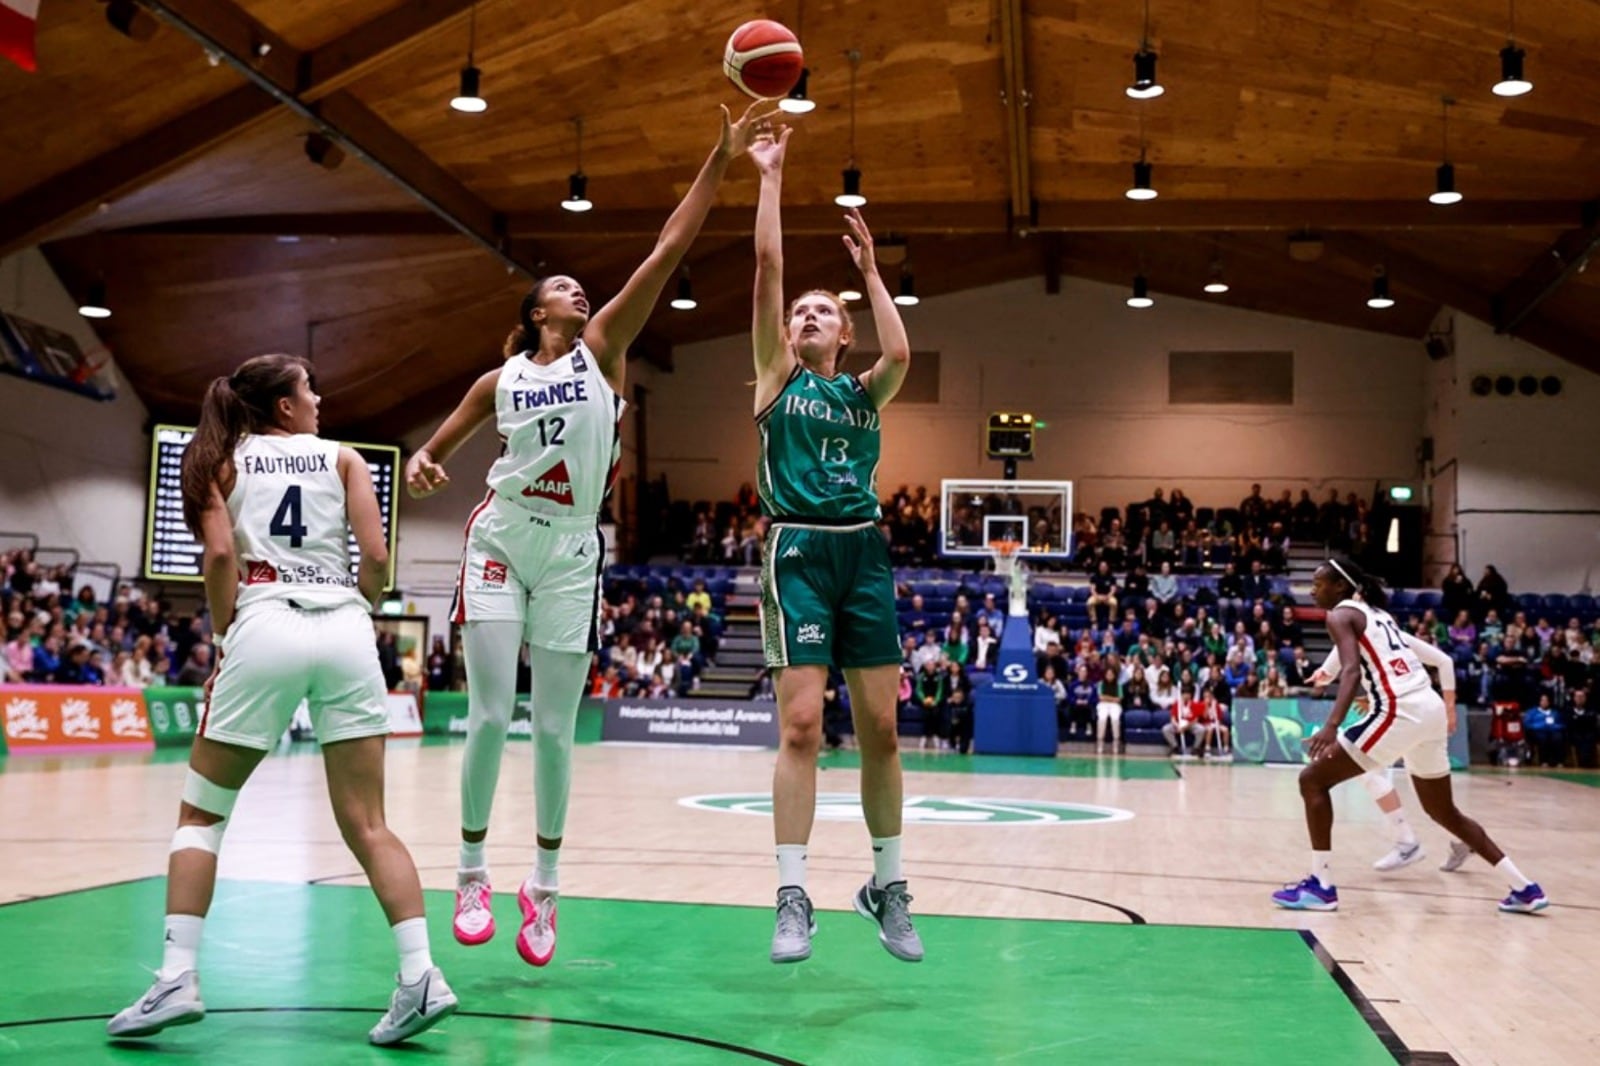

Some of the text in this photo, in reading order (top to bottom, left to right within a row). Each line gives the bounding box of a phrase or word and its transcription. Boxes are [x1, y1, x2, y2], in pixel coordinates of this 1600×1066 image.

[513, 380, 588, 412] FRANCE
[538, 416, 565, 447] 12
[820, 437, 849, 465] 13
[244, 453, 329, 475] FAUTHOUX
[530, 479, 572, 496] MAIF
[269, 484, 308, 548] 4
[529, 515, 552, 528] FRA
[619, 705, 671, 719] National
[671, 707, 734, 722] Basketball
